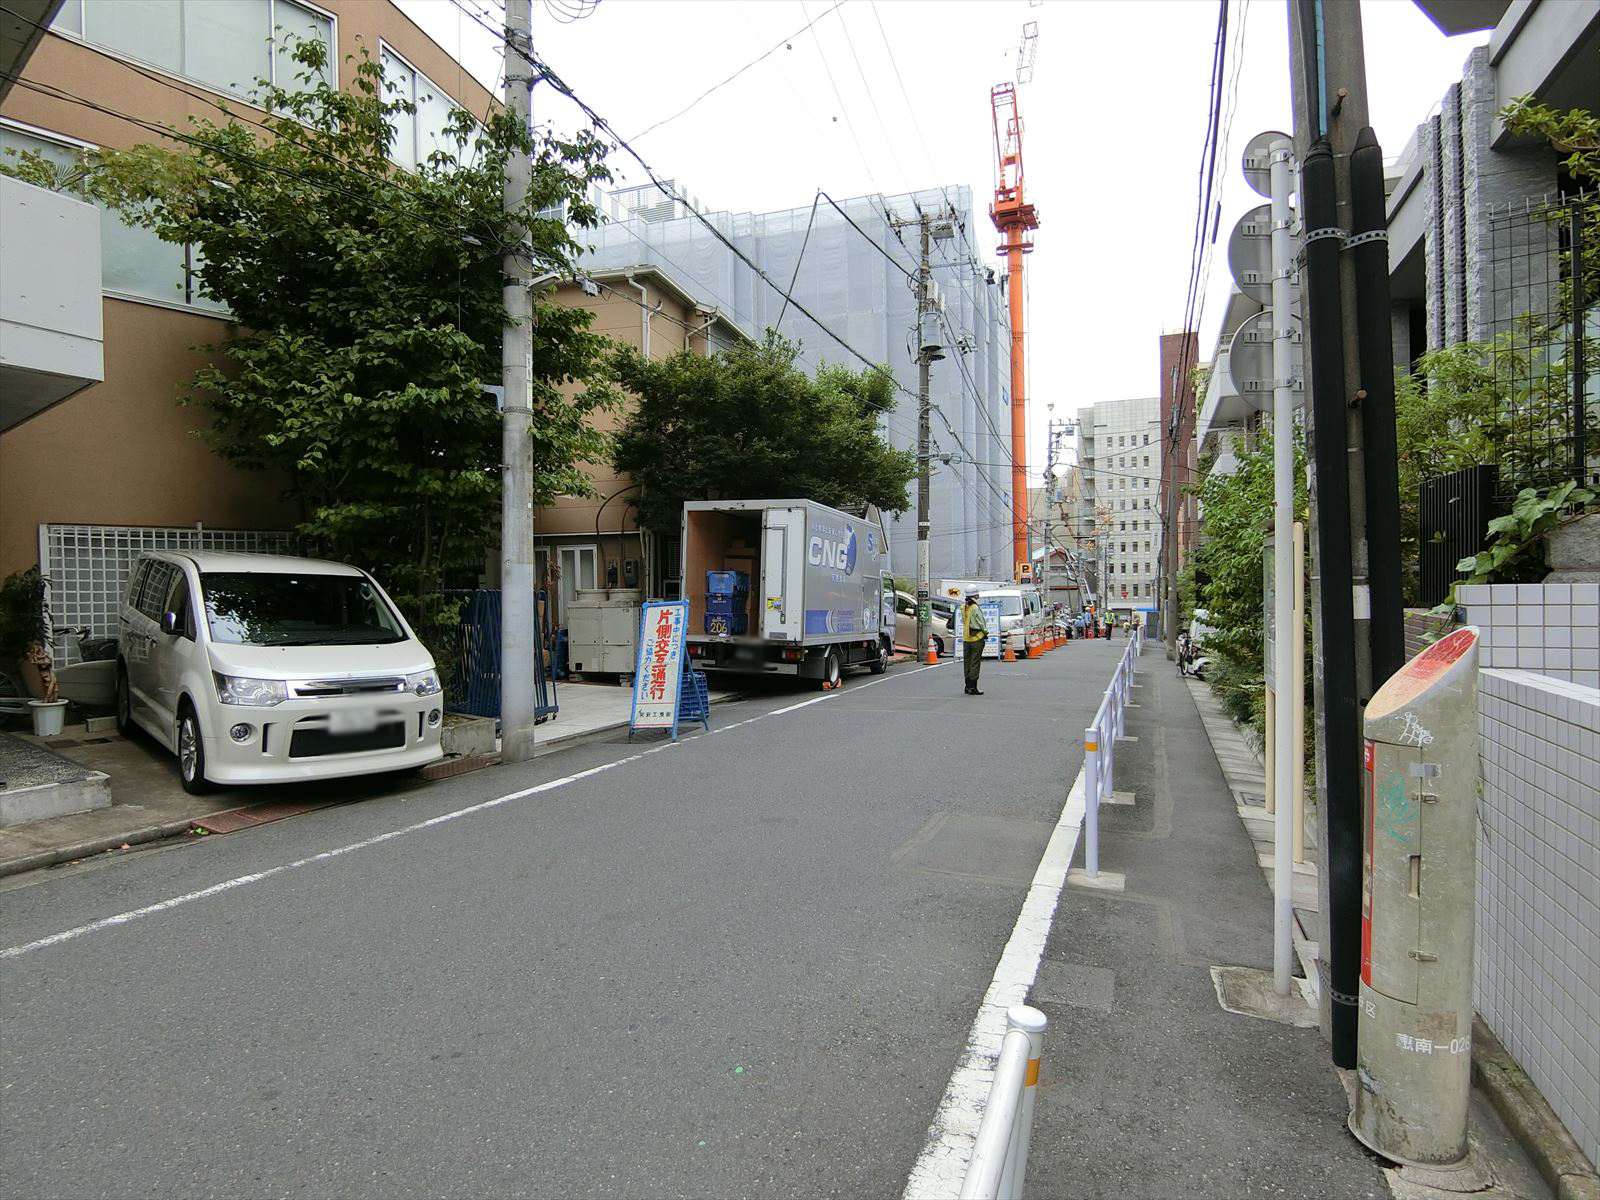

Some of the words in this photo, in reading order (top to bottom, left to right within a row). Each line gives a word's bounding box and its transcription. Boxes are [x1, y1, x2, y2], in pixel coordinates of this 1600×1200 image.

[808, 536, 848, 571] CNG
[1022, 565, 1030, 573] P
[670, 608, 681, 660] 工事中につき
[710, 622, 728, 633] 206
[641, 638, 655, 700] ご協力ください
[650, 609, 673, 700] 片側交互通行
